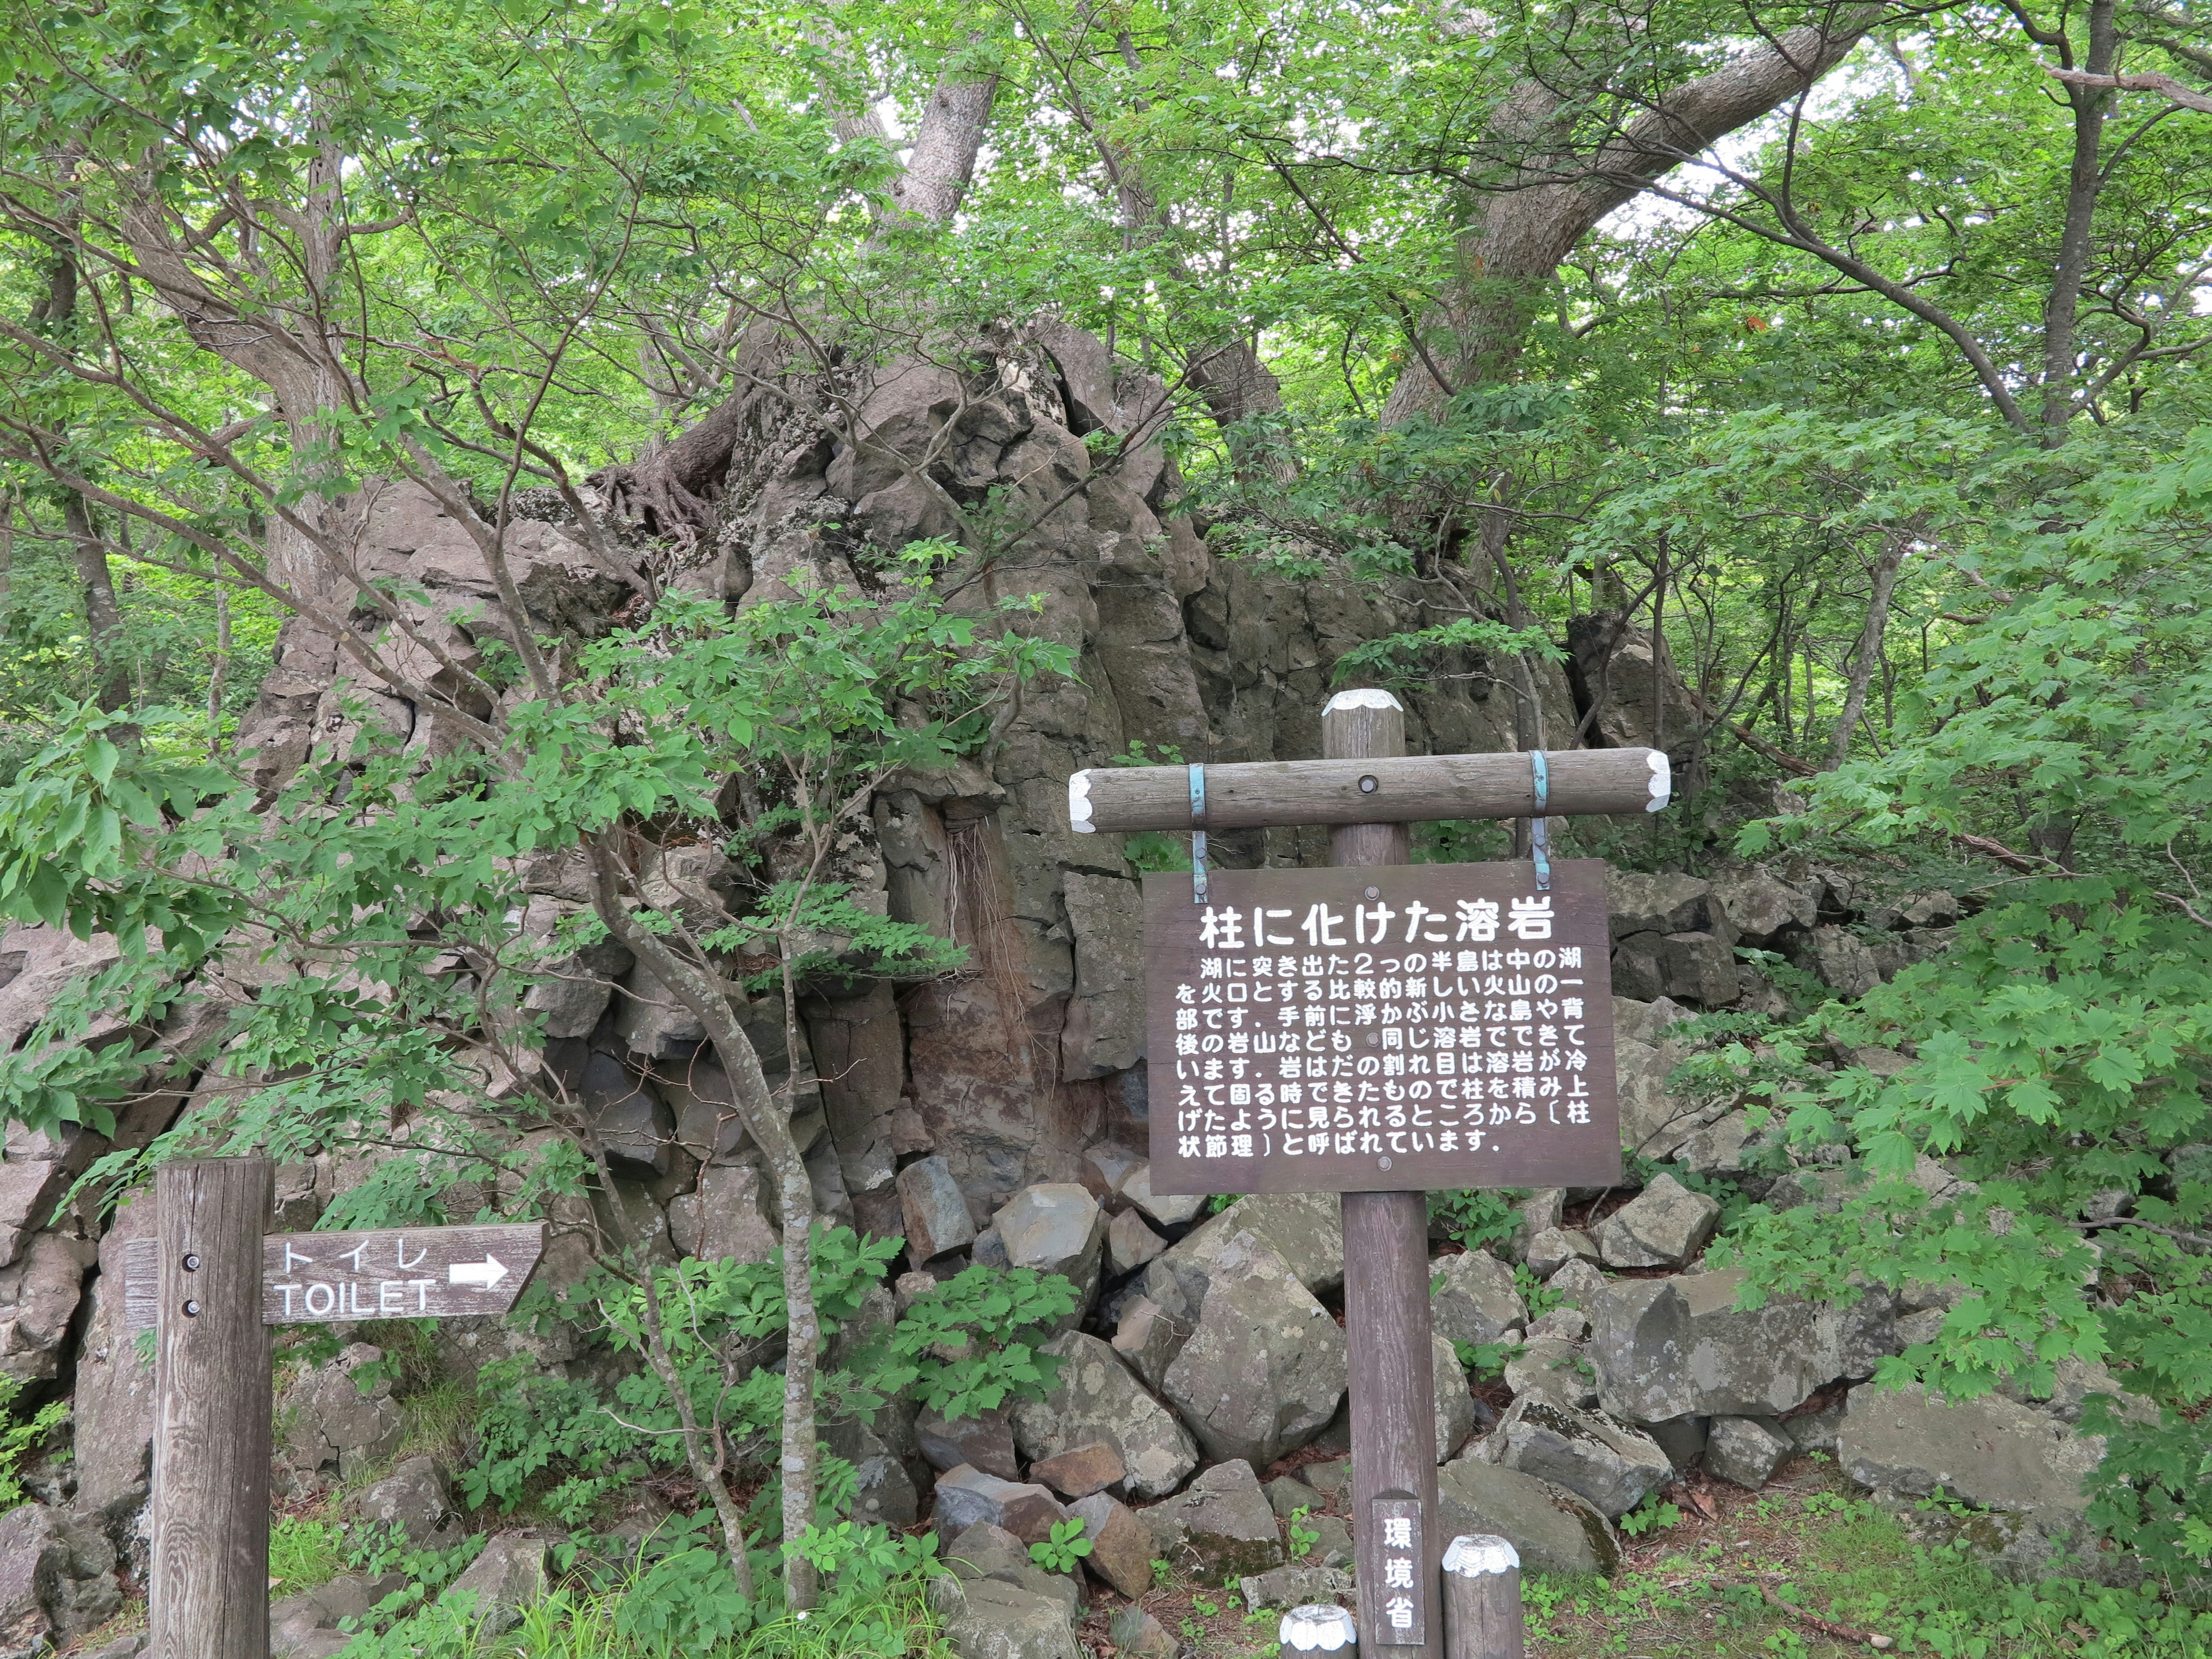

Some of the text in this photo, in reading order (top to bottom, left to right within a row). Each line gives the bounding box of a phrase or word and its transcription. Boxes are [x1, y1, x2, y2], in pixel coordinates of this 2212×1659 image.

[1199, 896, 1554, 949] 柱に化けた溶岩
[1201, 947, 1581, 978] 湖に突き出た2つの半島は中の湖
[1176, 974, 1584, 1004] を火口とする比較的新しい火山の一
[1178, 1075, 1589, 1106] えて固る時できたもので柱を積み上
[285, 1239, 427, 1274] トイレ
[273, 1279, 437, 1316] TOILET
[1384, 1517, 1414, 1629] 環境省
